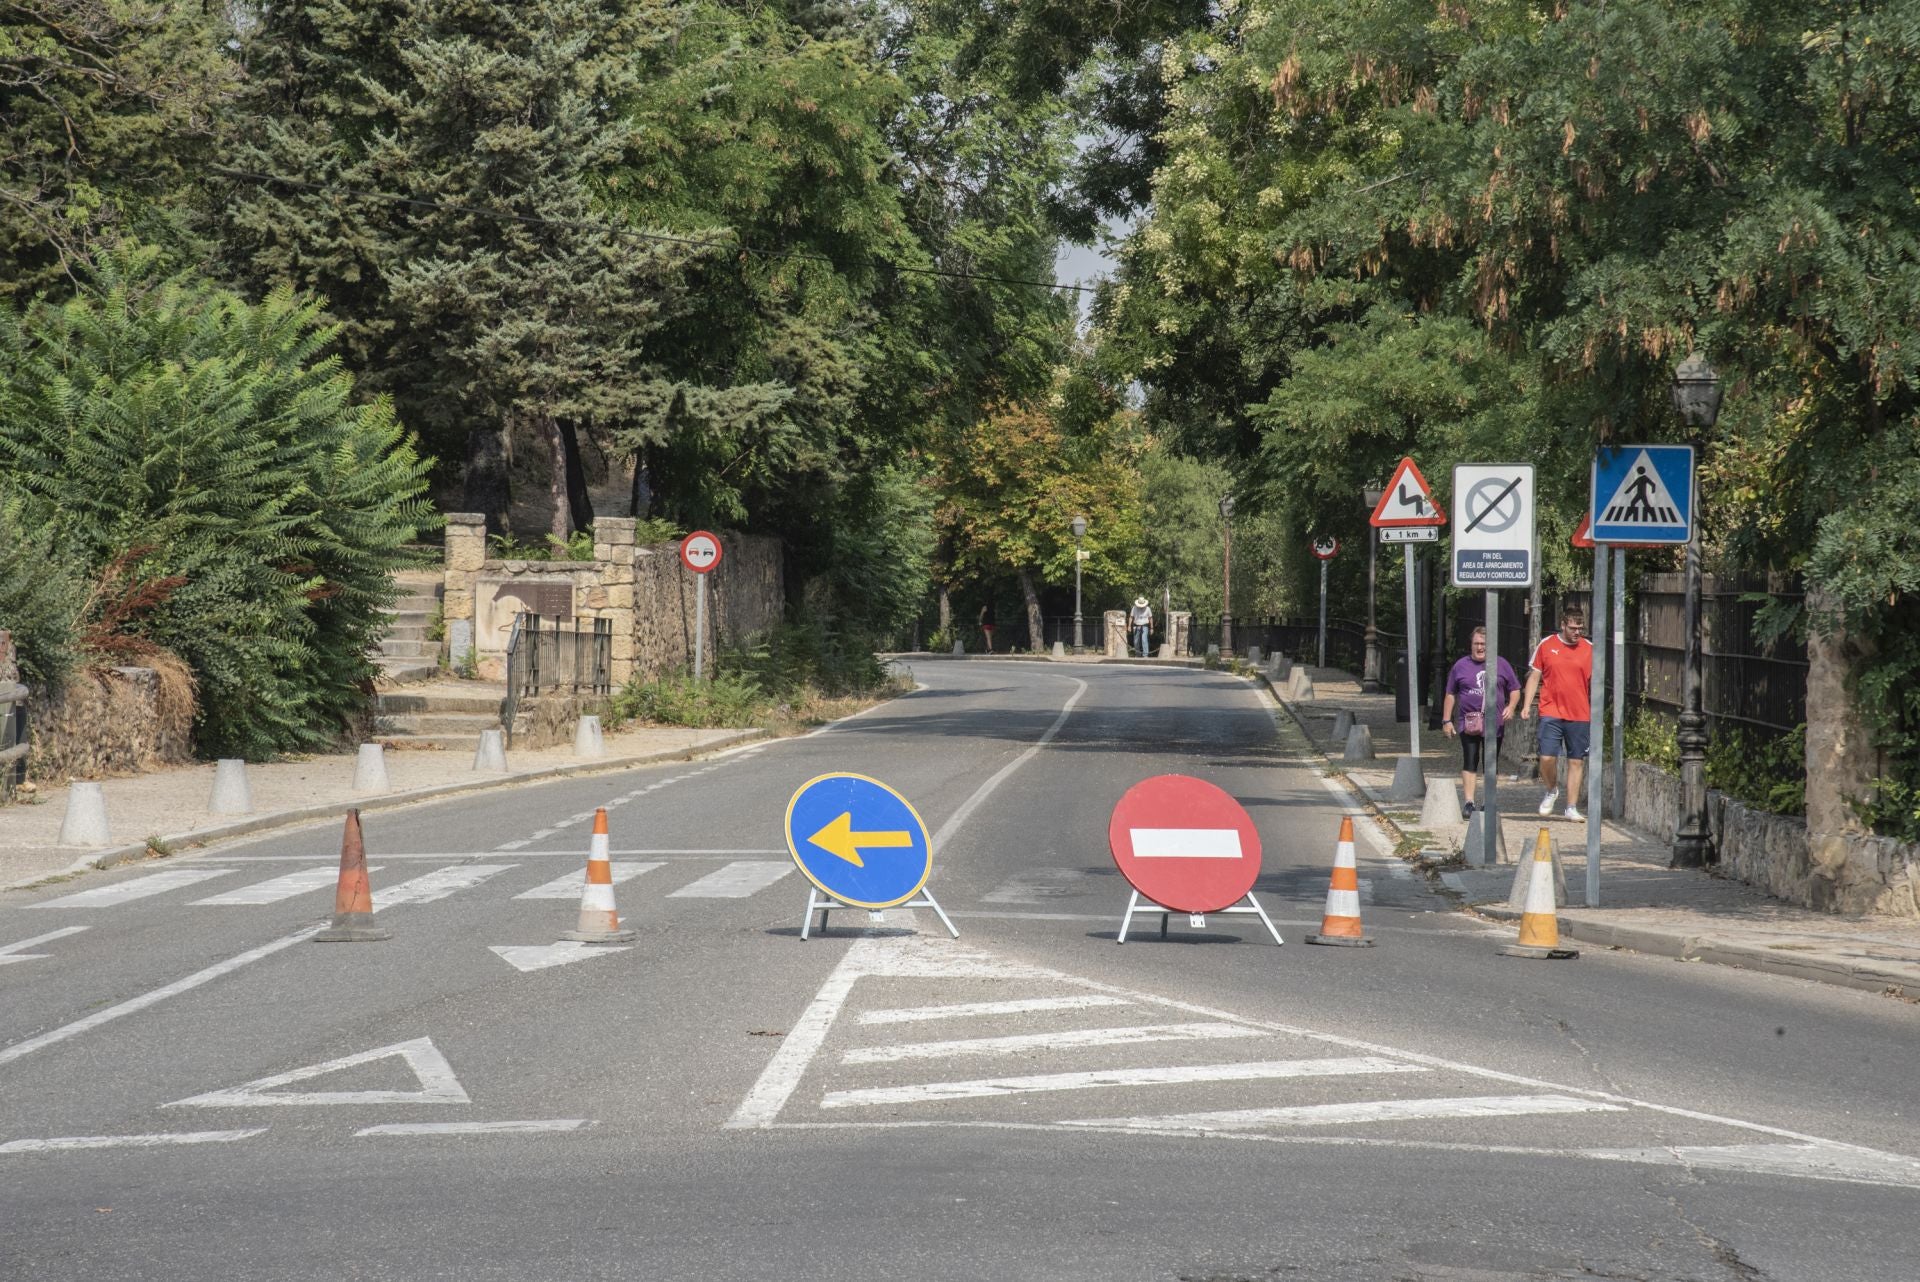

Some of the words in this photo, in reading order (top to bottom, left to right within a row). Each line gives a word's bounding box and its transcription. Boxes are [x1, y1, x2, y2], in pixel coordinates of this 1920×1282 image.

[1482, 552, 1491, 560] FIN
[1492, 552, 1503, 560] DEL
[1459, 571, 1486, 579] REGULADO
[1491, 571, 1526, 579] CONTROLADO
